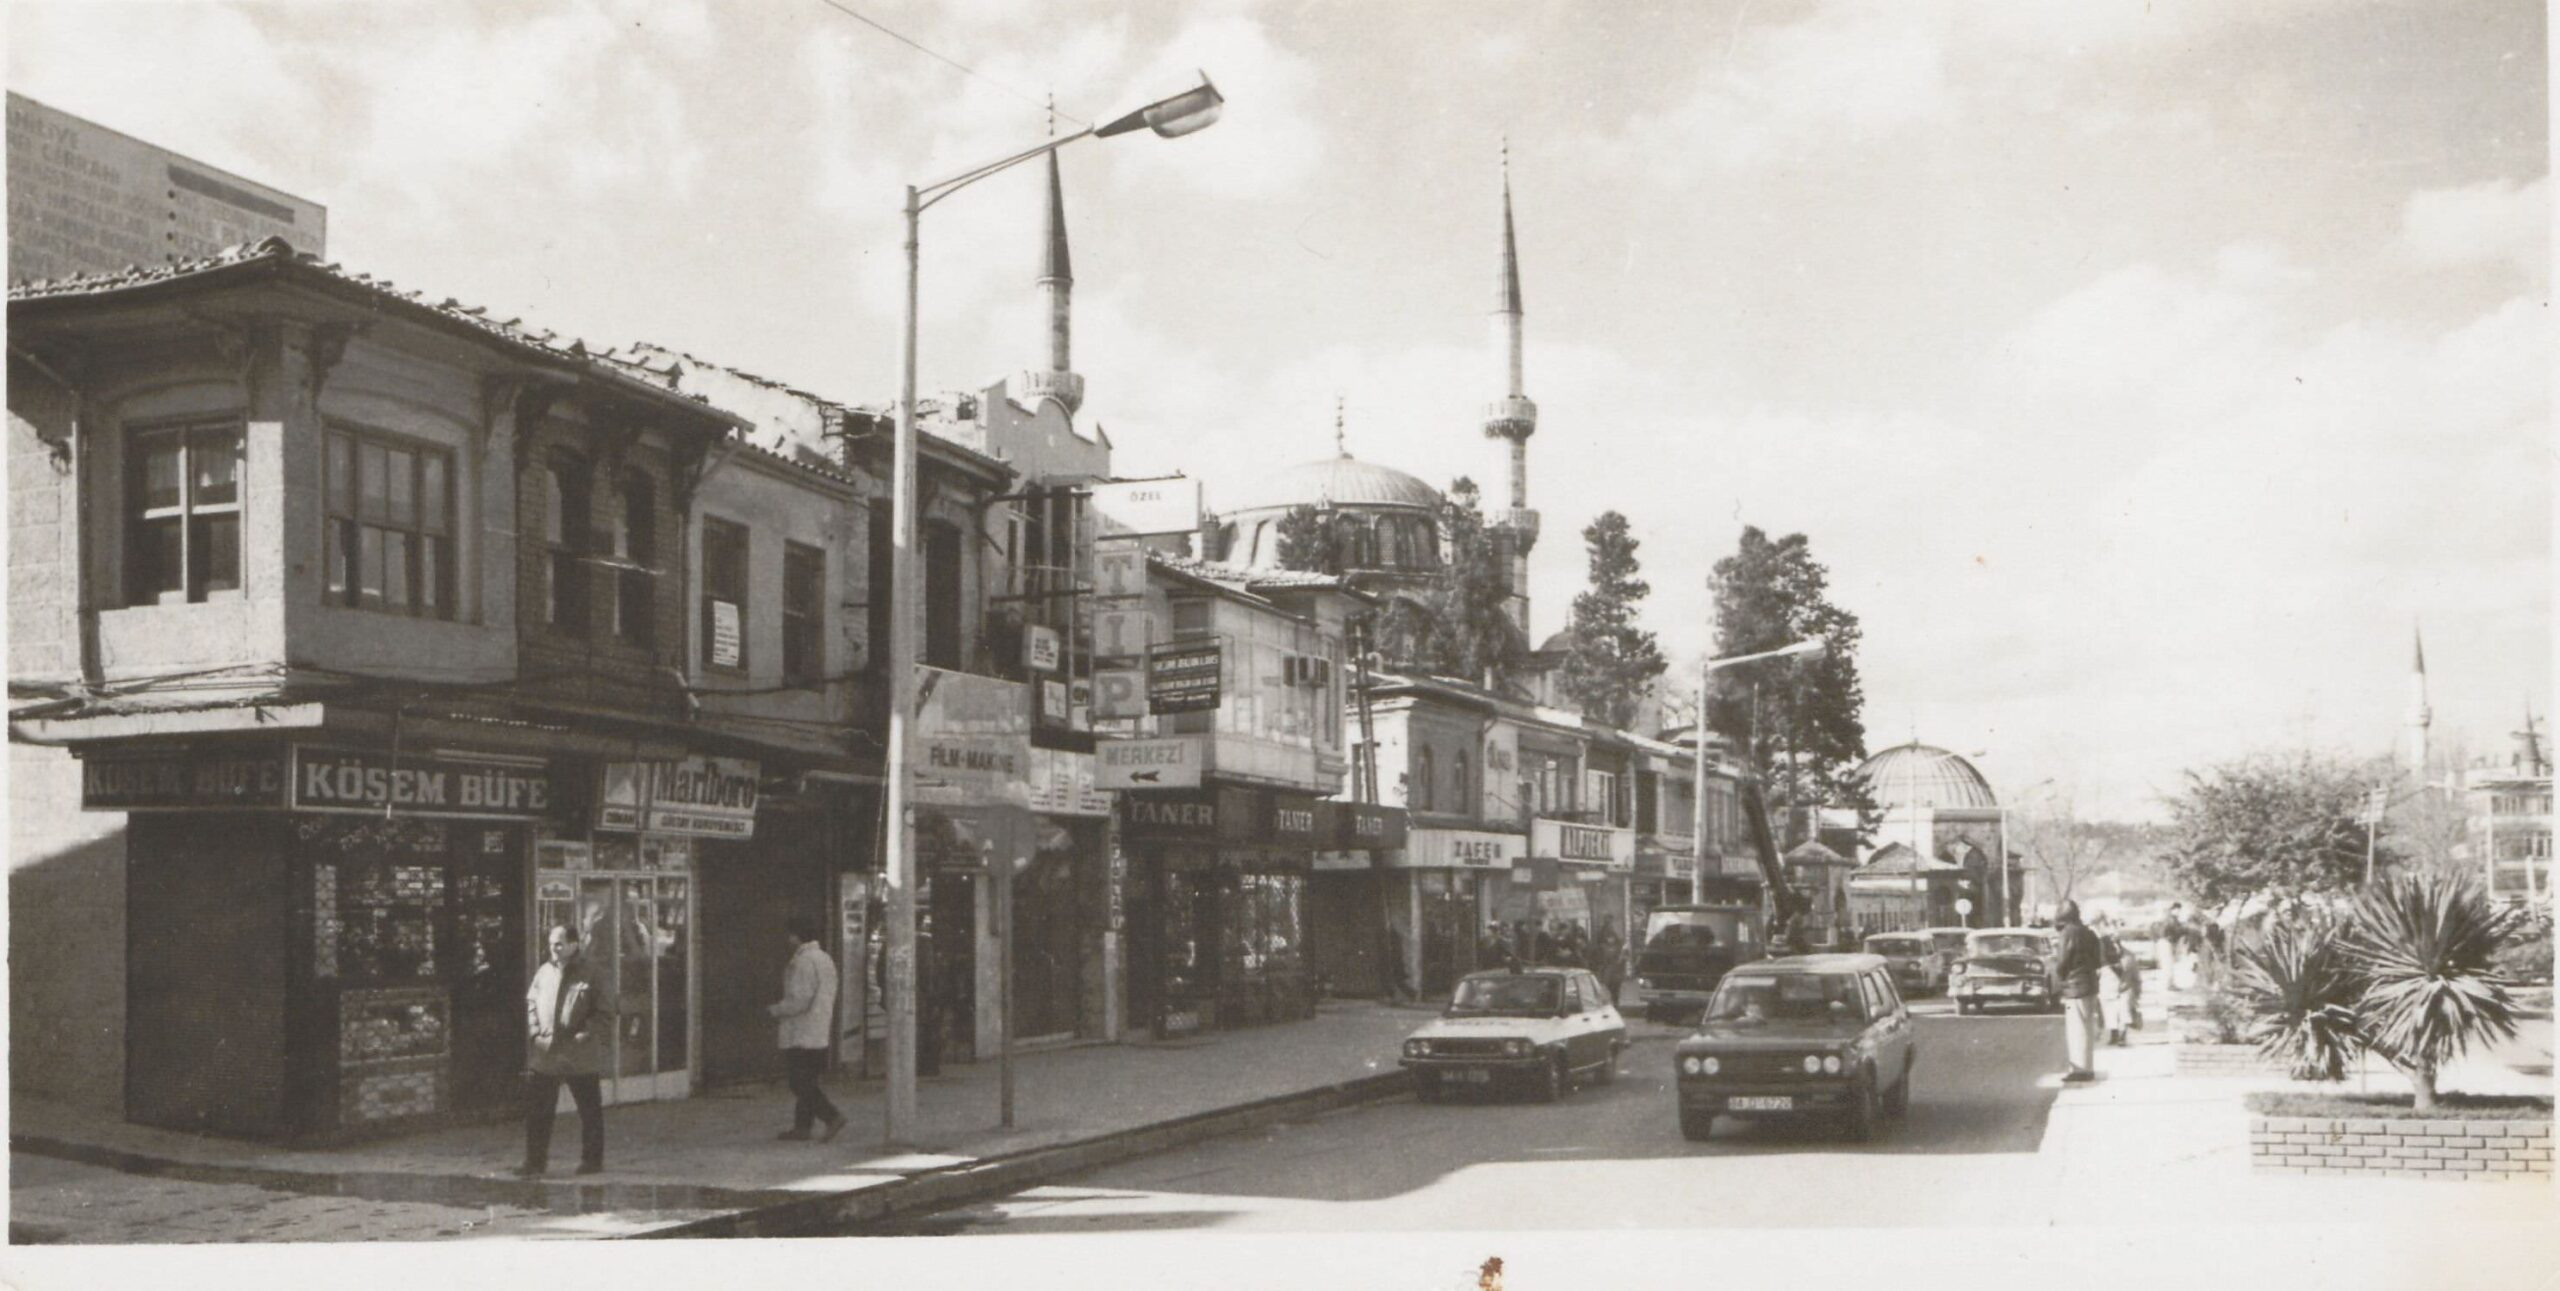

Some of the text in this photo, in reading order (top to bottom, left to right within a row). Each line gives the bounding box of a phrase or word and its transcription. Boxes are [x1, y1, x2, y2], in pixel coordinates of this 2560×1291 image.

[1105, 742, 1184, 766] MERKEZİ
[458, 769, 548, 809] BÜFE
[653, 758, 757, 809] Marlboro
[1129, 799, 1214, 825] TANER
[1276, 808, 1313, 832] TANER
[1355, 814, 1384, 835] TANER
